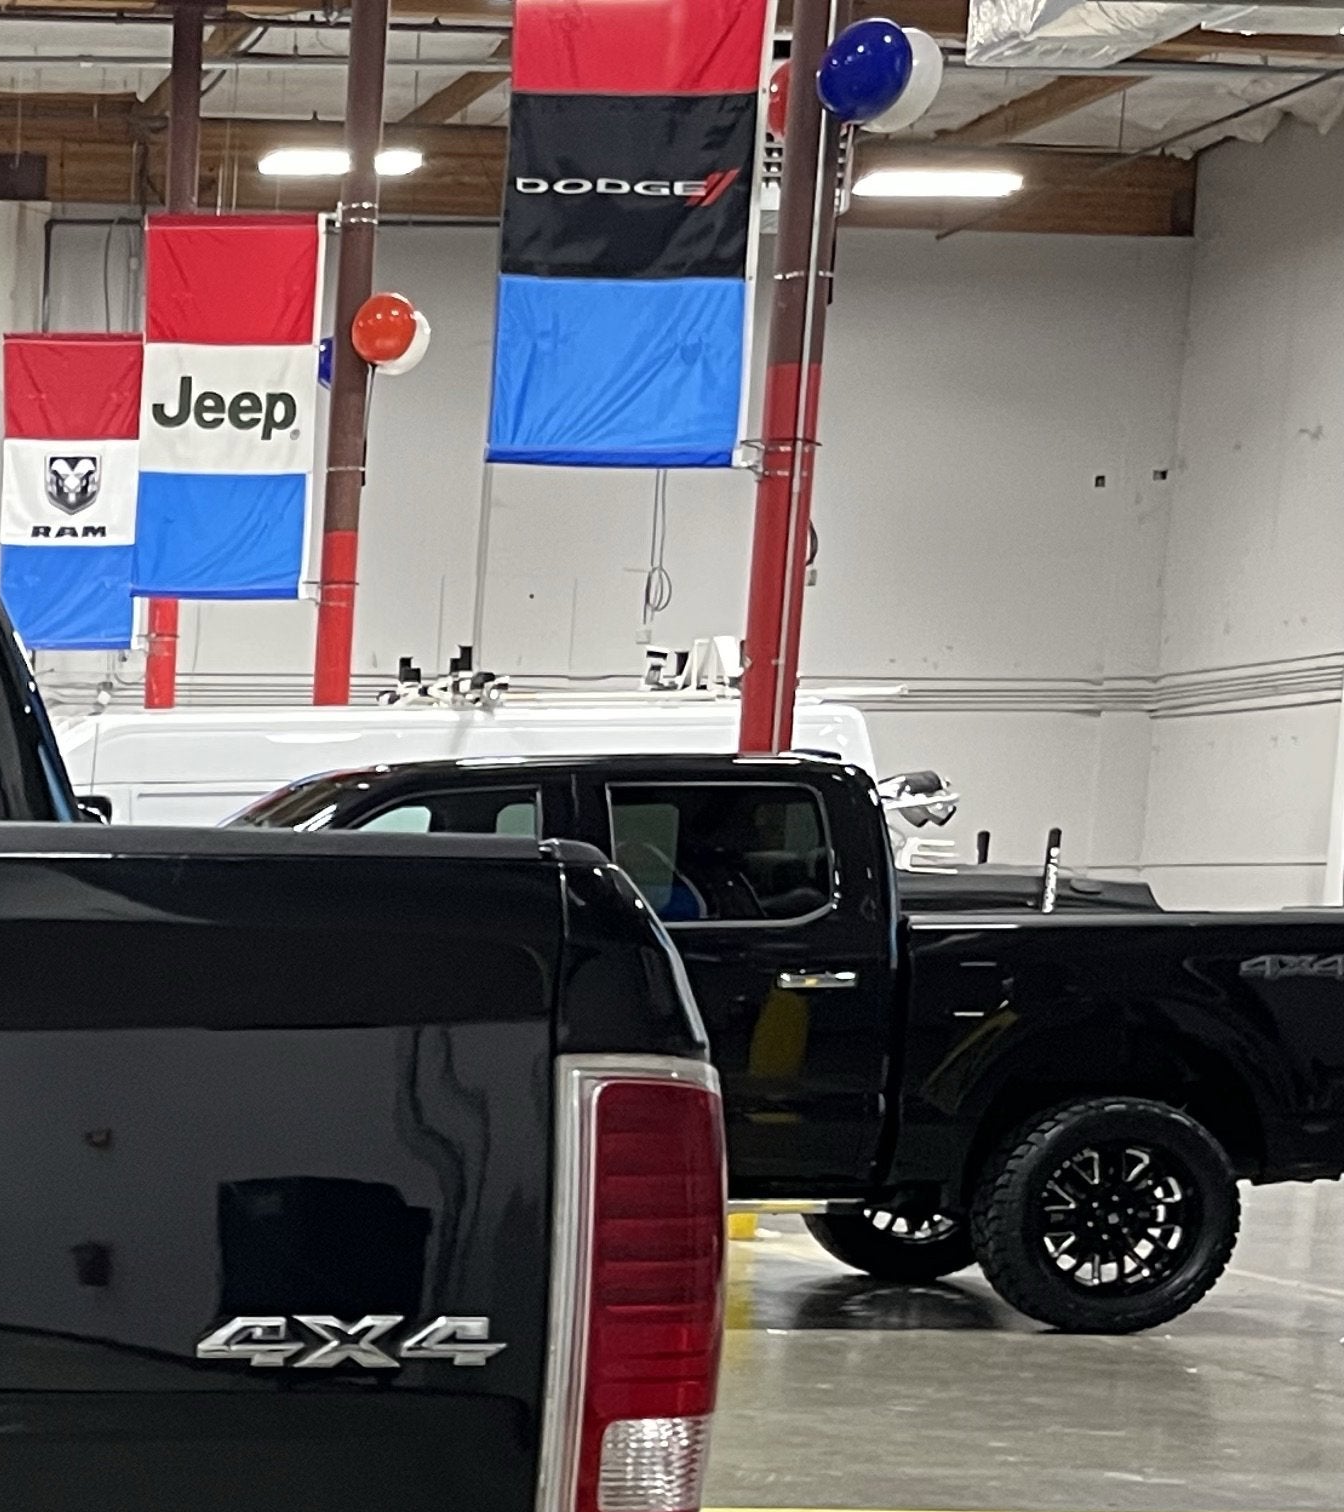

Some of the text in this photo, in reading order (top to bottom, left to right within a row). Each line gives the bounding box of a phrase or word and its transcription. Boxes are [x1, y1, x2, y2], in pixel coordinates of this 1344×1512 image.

[516, 177, 707, 197] DODGE
[152, 376, 297, 440] Jeep
[31, 525, 107, 538] RAM
[196, 1315, 508, 1368] 4X4
